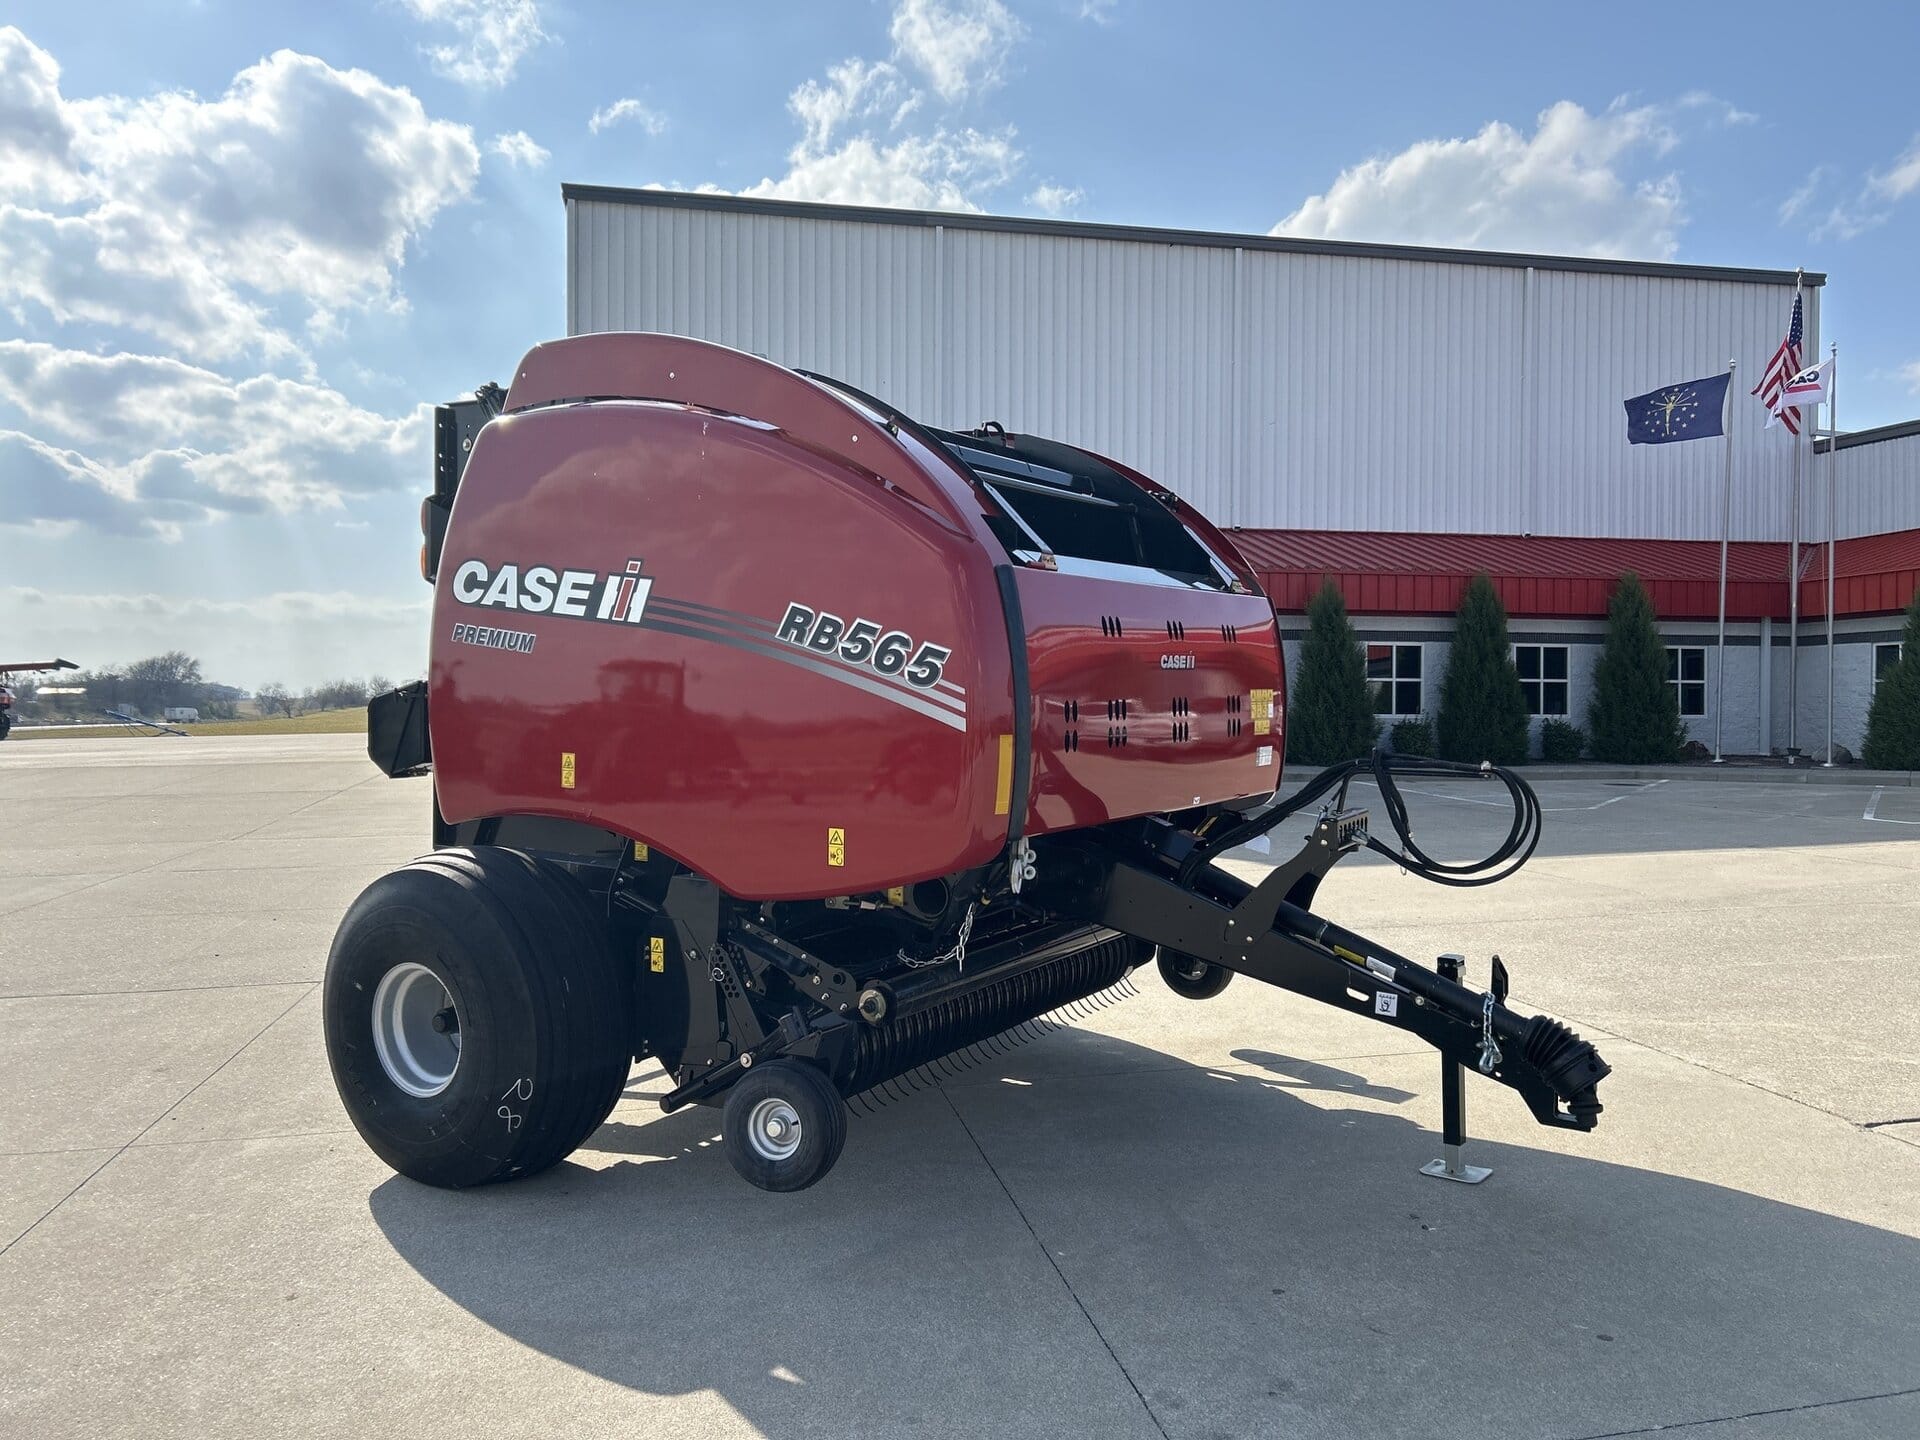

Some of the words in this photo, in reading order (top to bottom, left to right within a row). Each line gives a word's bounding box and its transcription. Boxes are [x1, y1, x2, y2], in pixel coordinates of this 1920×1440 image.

[452, 559, 597, 617] CASE
[451, 622, 537, 654] PREMIUM
[775, 601, 952, 689] RB565
[1160, 654, 1187, 669] CASE
